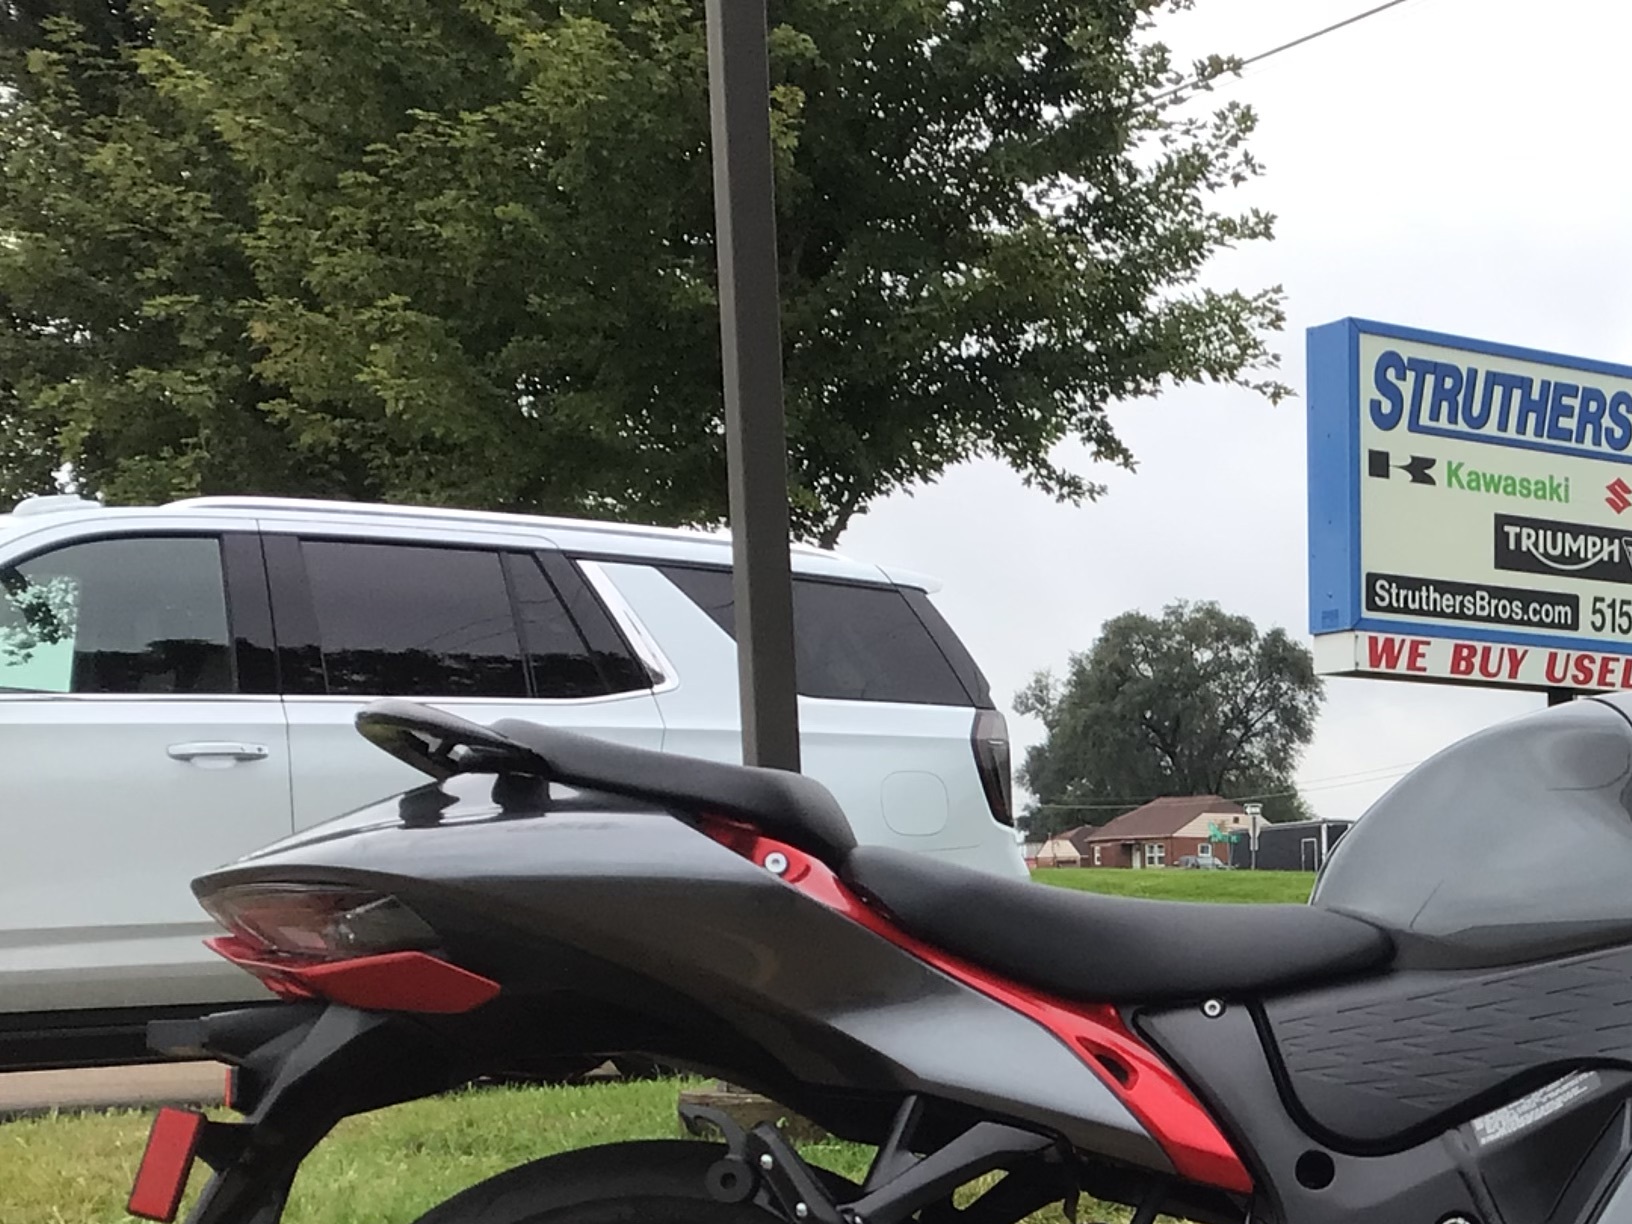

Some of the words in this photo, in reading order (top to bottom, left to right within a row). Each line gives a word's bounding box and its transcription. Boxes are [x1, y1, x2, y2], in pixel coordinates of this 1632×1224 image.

[1446, 461, 1570, 503] Kawasaki
[1503, 525, 1620, 568] TRIUMPH
[1374, 581, 1572, 625] StruthersBros.com
[1367, 635, 1431, 672] WE
[1450, 645, 1528, 679] BUY
